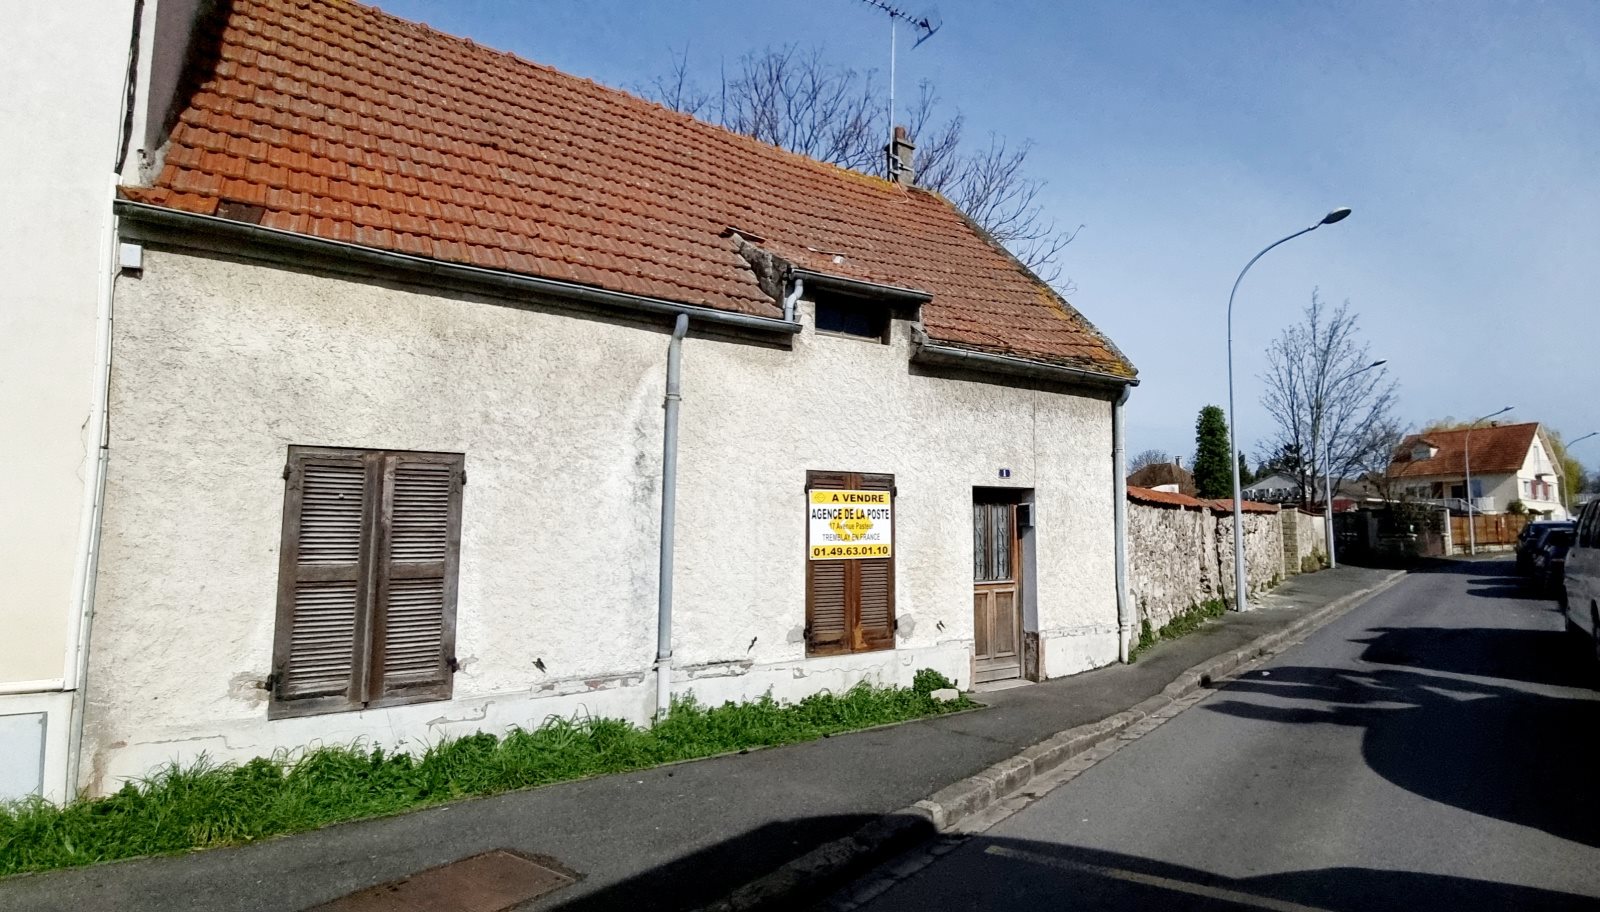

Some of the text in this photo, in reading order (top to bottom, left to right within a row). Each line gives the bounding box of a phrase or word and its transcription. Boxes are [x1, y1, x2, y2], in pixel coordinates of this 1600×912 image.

[832, 494, 884, 502] A VENDRE
[812, 509, 889, 519] AGENCE DE LA POSTE
[837, 522, 854, 530] Avenue
[856, 522, 874, 530] Pasteur
[822, 533, 880, 541] TREMBLAY EN FRANCE
[814, 546, 888, 556] 01.49.63.01.10
